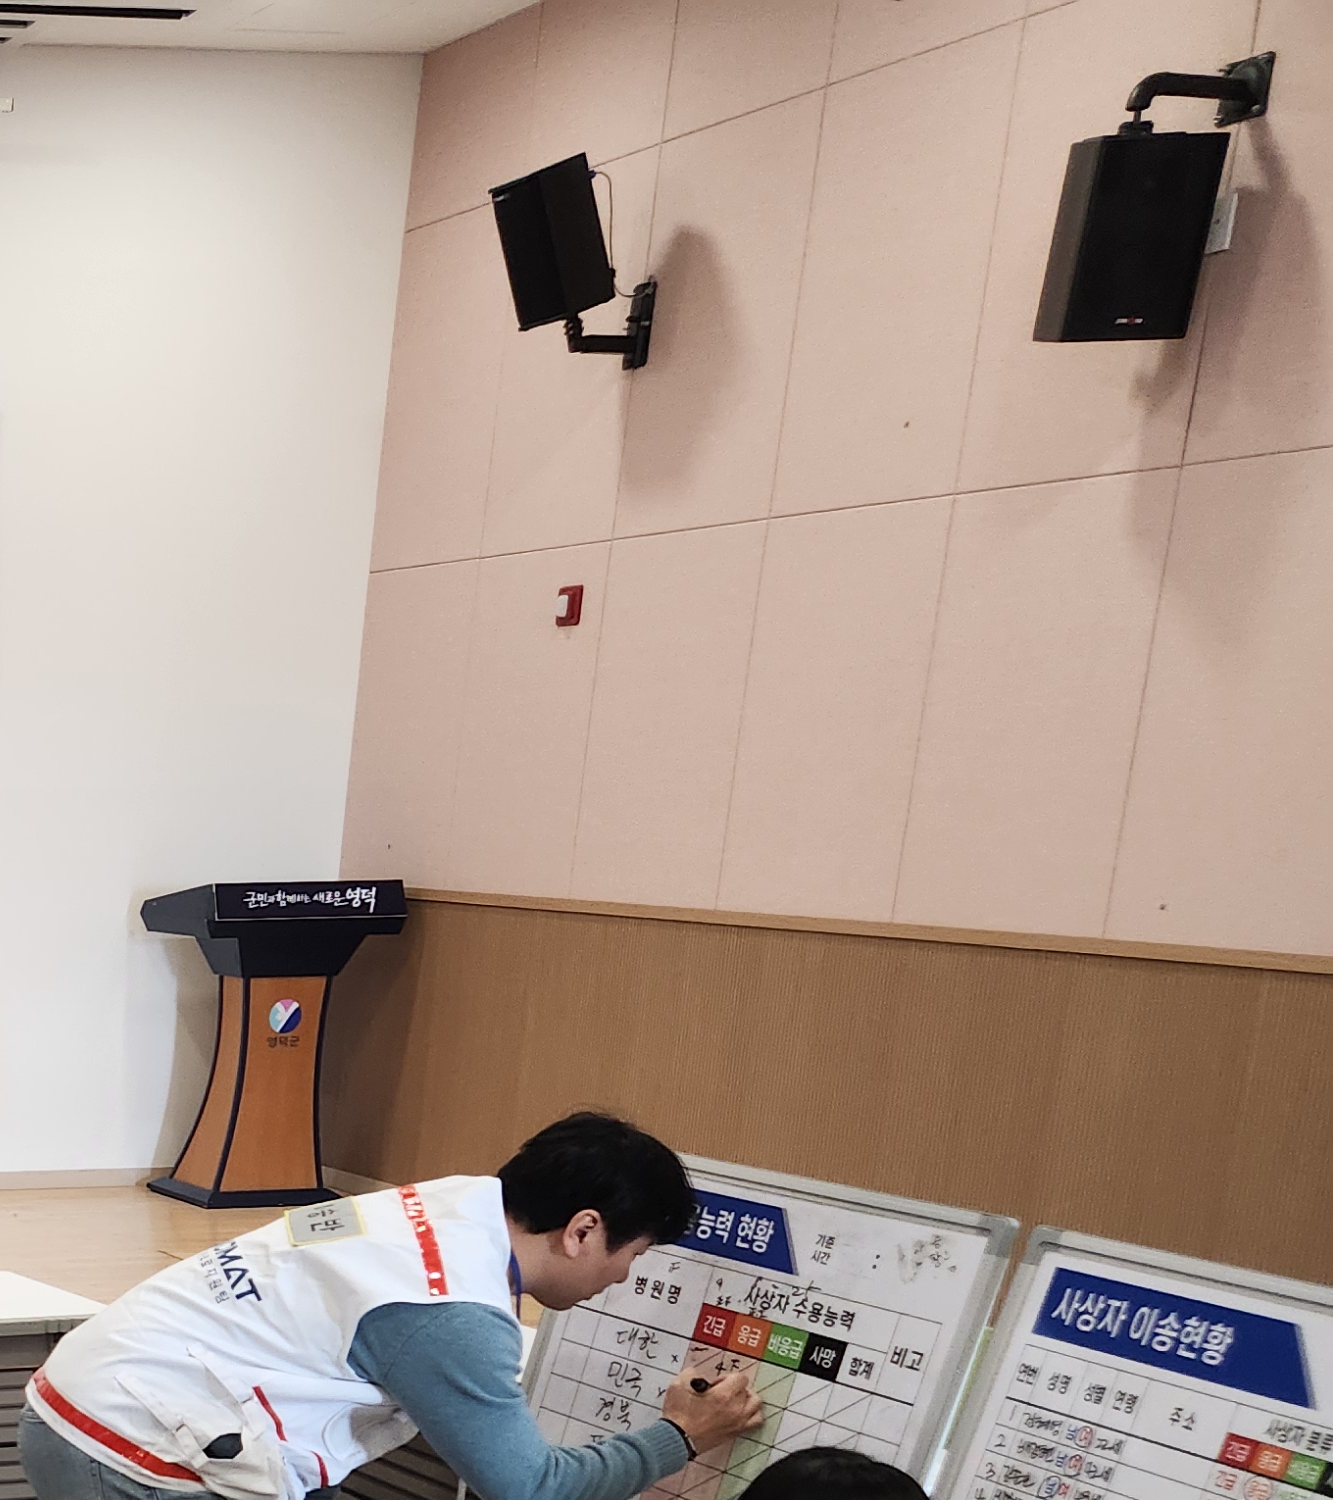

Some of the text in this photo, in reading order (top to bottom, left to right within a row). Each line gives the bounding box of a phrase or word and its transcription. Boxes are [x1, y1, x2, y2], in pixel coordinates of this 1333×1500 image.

[345, 887, 377, 913] 영덕
[266, 1035, 300, 1048] 영덕군
[684, 1204, 776, 1253] 능력 현황
[815, 1233, 836, 1250] 기준
[810, 1250, 832, 1266] 시간
[634, 1275, 682, 1305] 병원명
[744, 1285, 856, 1333] 사상자 수용능력
[1051, 1287, 1235, 1367] 사상자 이송현황
[702, 1314, 926, 1380] 긴급 응급 비응급 사망 합계 비고
[1168, 1406, 1198, 1432] 주소
